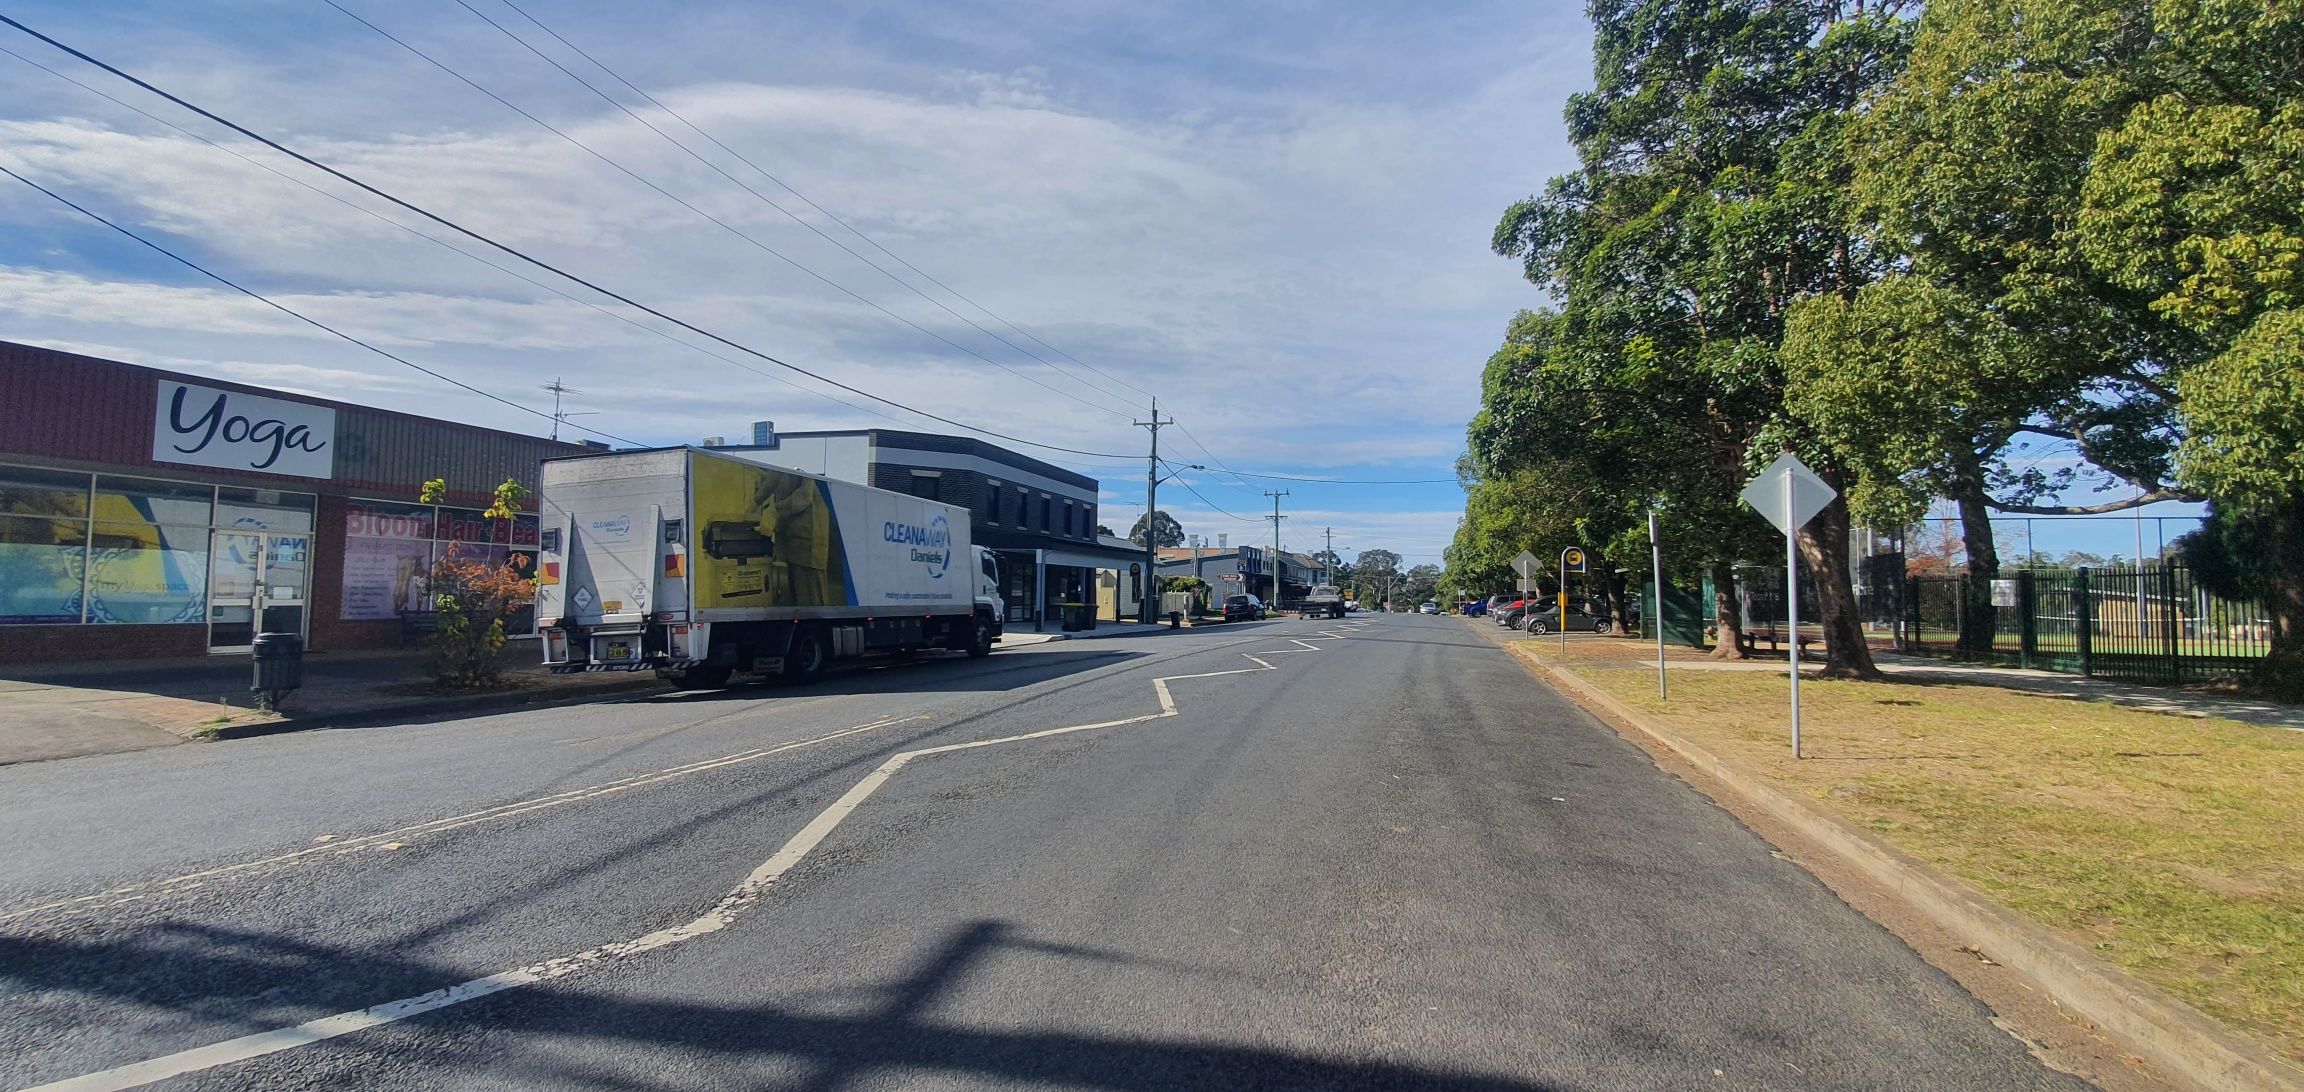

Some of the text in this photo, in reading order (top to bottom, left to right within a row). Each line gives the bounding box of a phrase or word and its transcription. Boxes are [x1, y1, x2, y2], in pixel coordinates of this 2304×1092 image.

[170, 386, 327, 469] Yoga
[346, 504, 433, 539] Bloom
[438, 512, 484, 542] Hair
[884, 521, 946, 548] CLEANAWAY
[910, 548, 943, 564] Daniels
